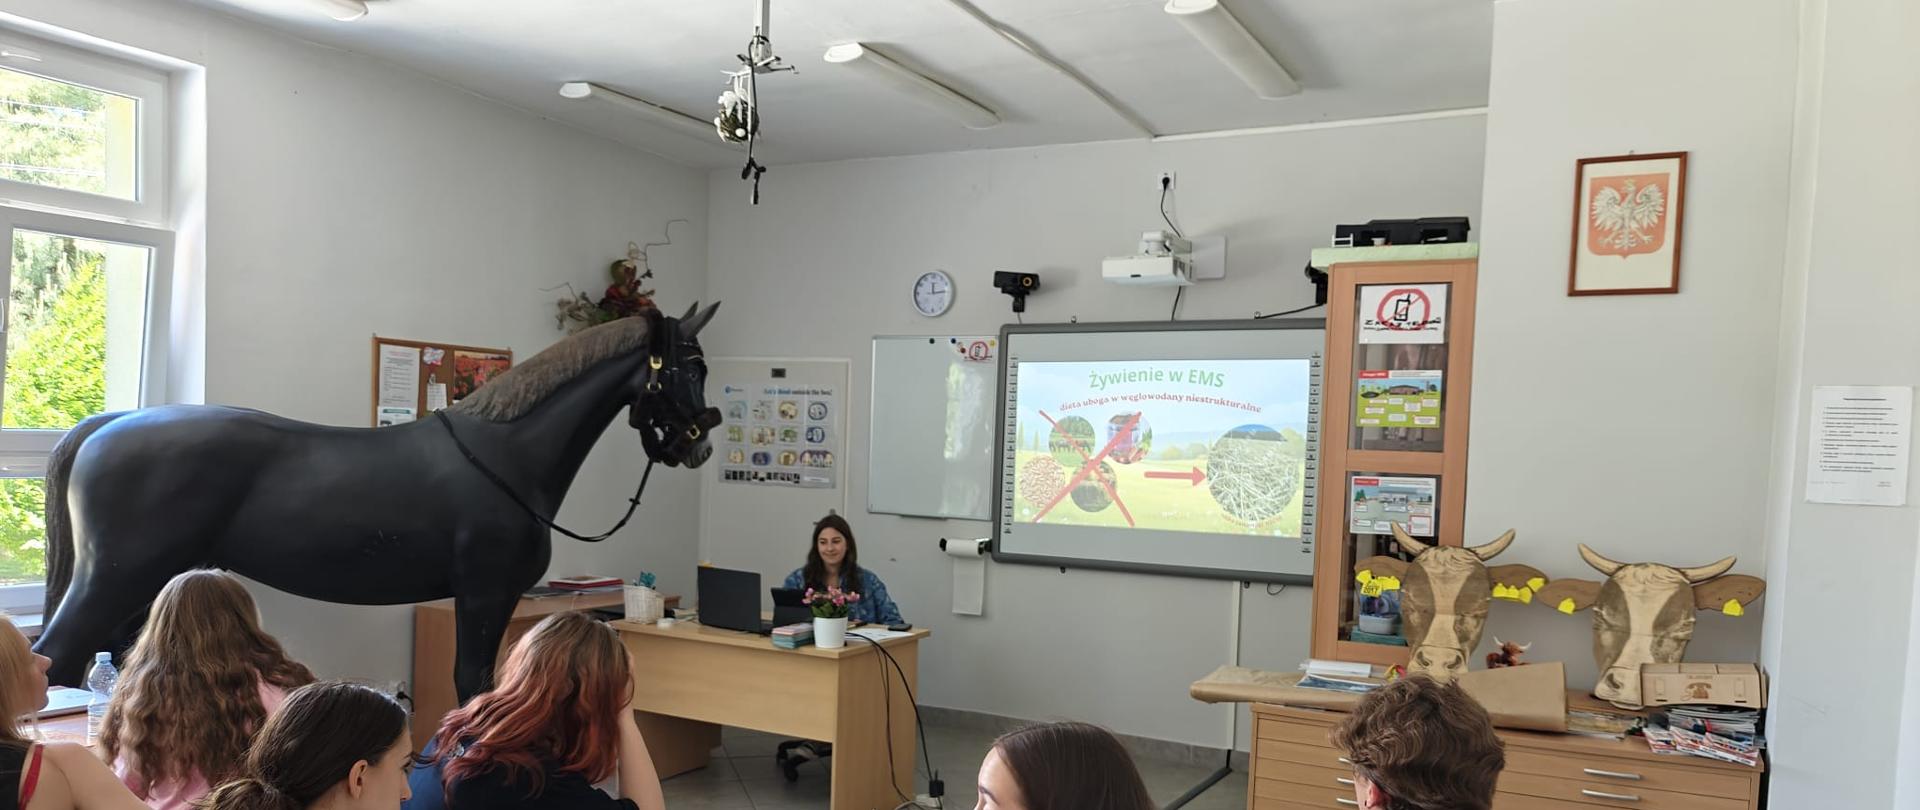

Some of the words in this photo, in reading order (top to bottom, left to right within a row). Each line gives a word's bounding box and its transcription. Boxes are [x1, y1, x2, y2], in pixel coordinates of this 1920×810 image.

[1089, 367, 1164, 391] Żywienie
[1168, 369, 1184, 382] w
[1188, 368, 1225, 388] EMS
[1059, 402, 1082, 412] dieta
[1082, 396, 1110, 408] uboga
[1121, 392, 1184, 403] węglowodany
[1185, 394, 1262, 414] niestrukturalne
